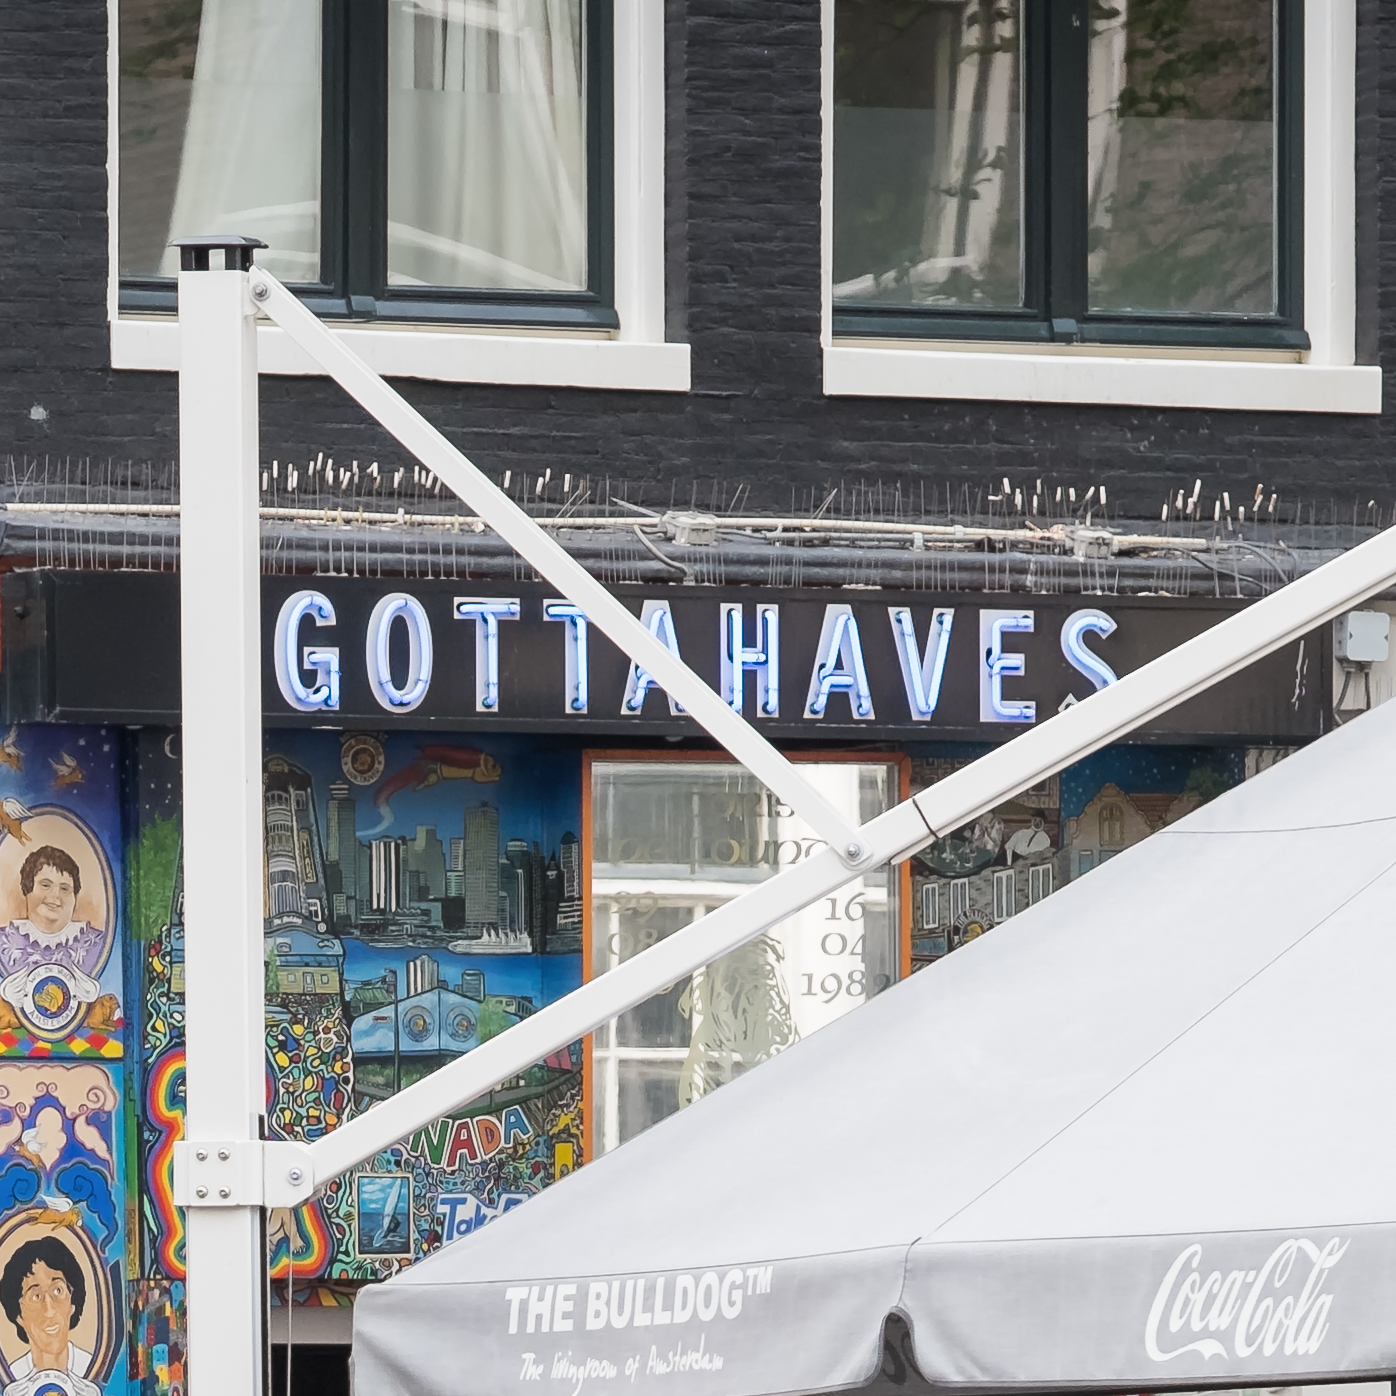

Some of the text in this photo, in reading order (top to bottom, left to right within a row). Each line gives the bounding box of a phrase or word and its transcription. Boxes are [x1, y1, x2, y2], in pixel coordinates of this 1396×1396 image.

[273, 588, 1120, 726] GOTTAHAVES
[824, 891, 866, 921] 16
[503, 1282, 575, 1335] THE
[1144, 1235, 1352, 1363] Coca-Cola
[519, 1351, 543, 1382] The
[625, 1353, 641, 1383] of
[645, 1333, 725, 1378] Amsterdam
